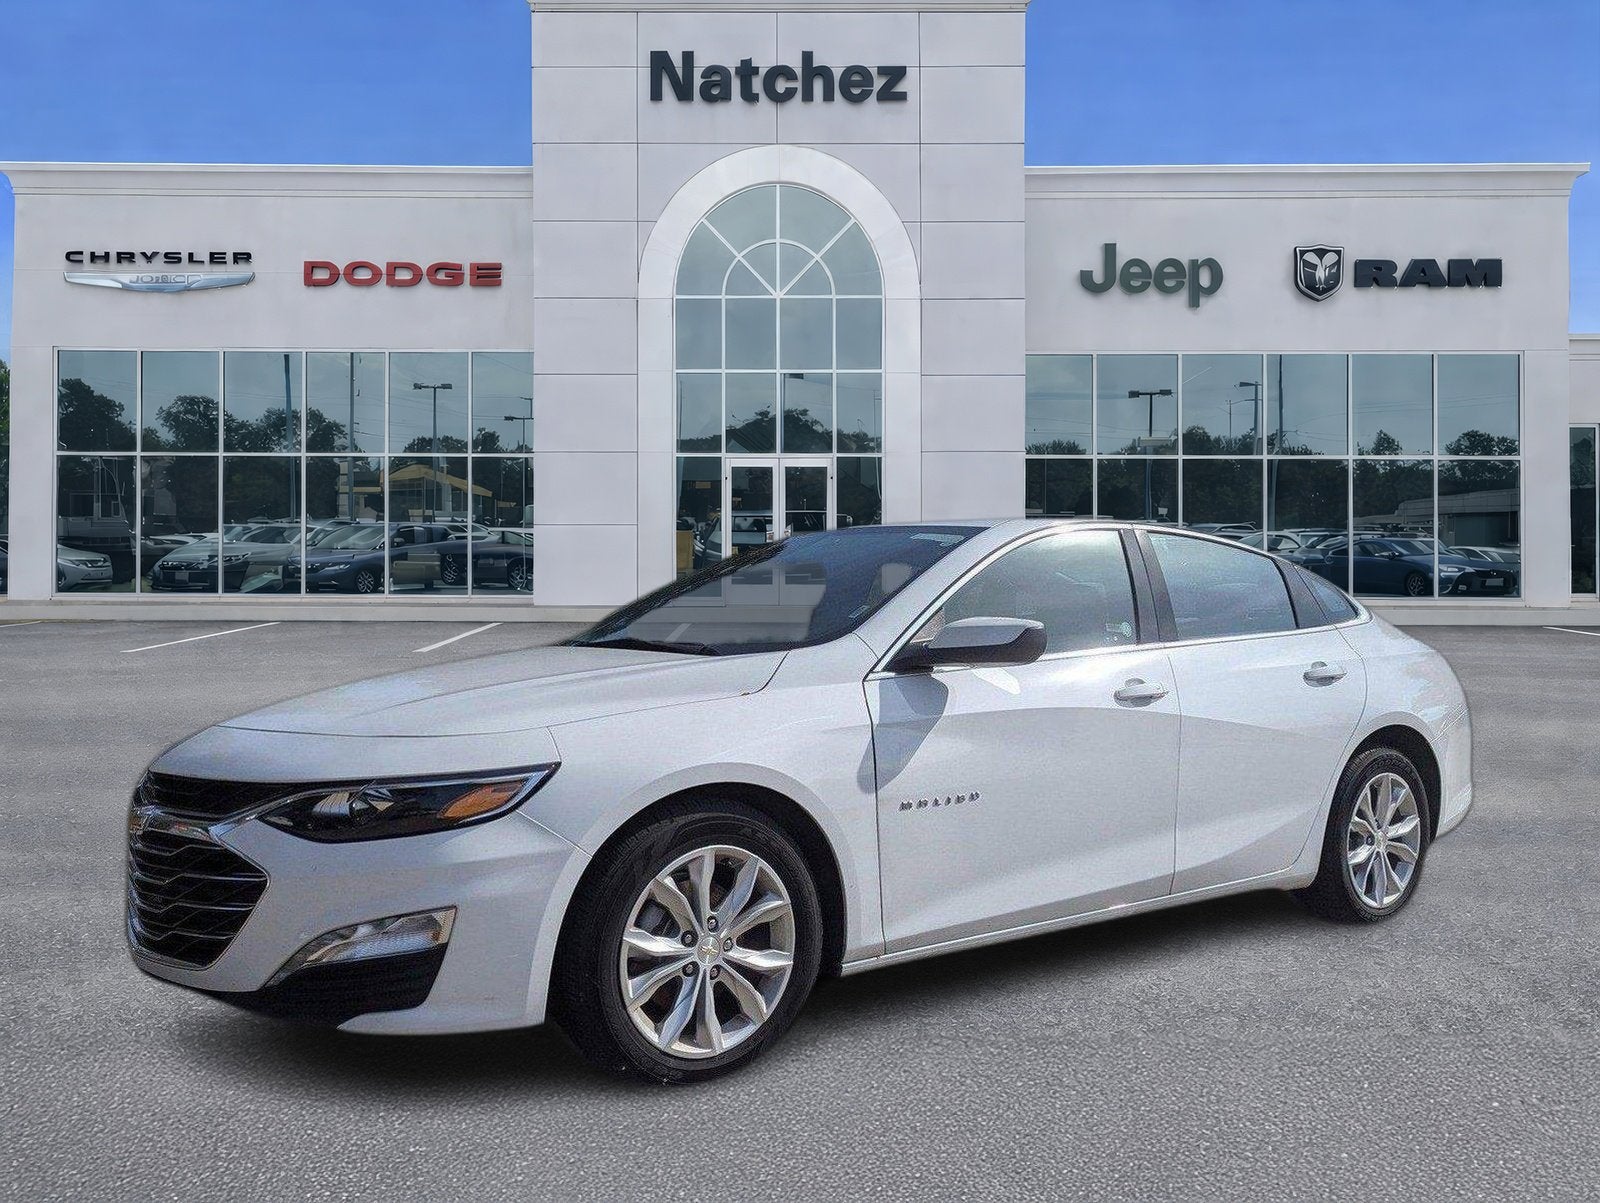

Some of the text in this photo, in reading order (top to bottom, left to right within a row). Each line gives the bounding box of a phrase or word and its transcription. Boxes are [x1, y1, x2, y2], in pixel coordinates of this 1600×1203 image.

[650, 51, 907, 105] Natchez
[65, 251, 253, 264] CHRYSLER
[304, 261, 503, 287] DODGE
[1080, 243, 1223, 309] Jeep
[1354, 259, 1503, 288] RAM
